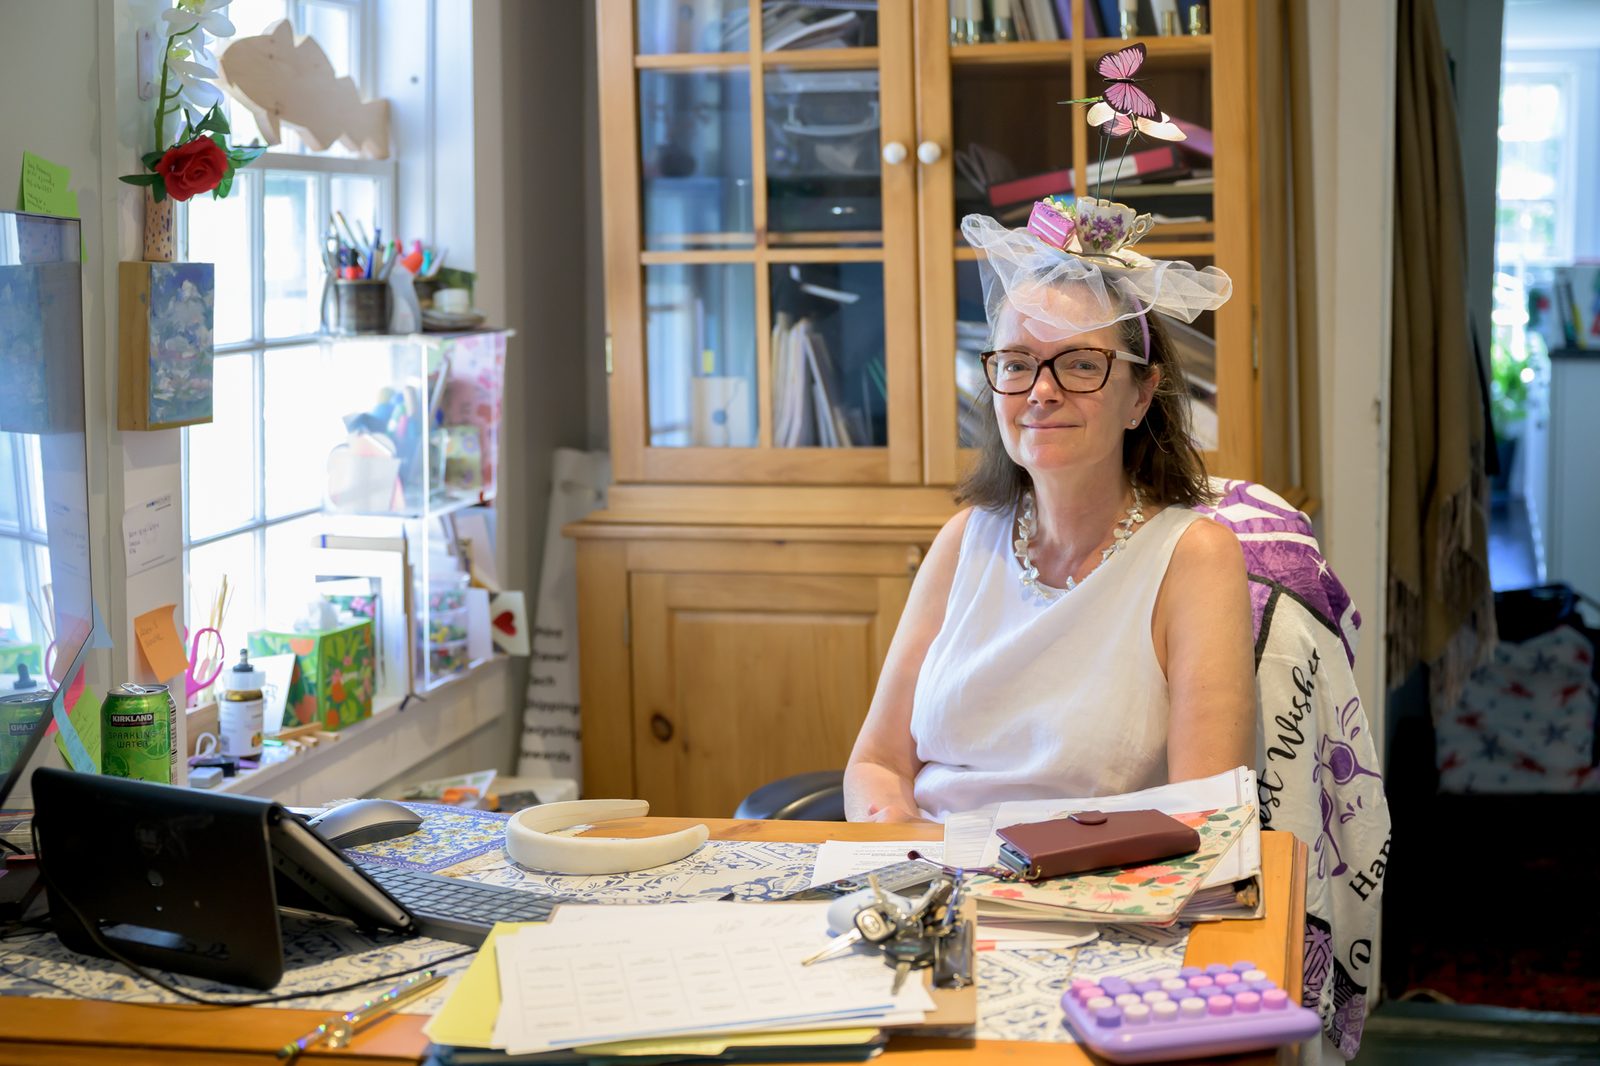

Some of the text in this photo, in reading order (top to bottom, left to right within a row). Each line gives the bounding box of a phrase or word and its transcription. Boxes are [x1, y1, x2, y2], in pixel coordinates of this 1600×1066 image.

[112, 713, 153, 723] KIRKLAND
[117, 741, 148, 749] WATER
[1257, 768, 1284, 831] est
[1349, 828, 1391, 902] Hap
